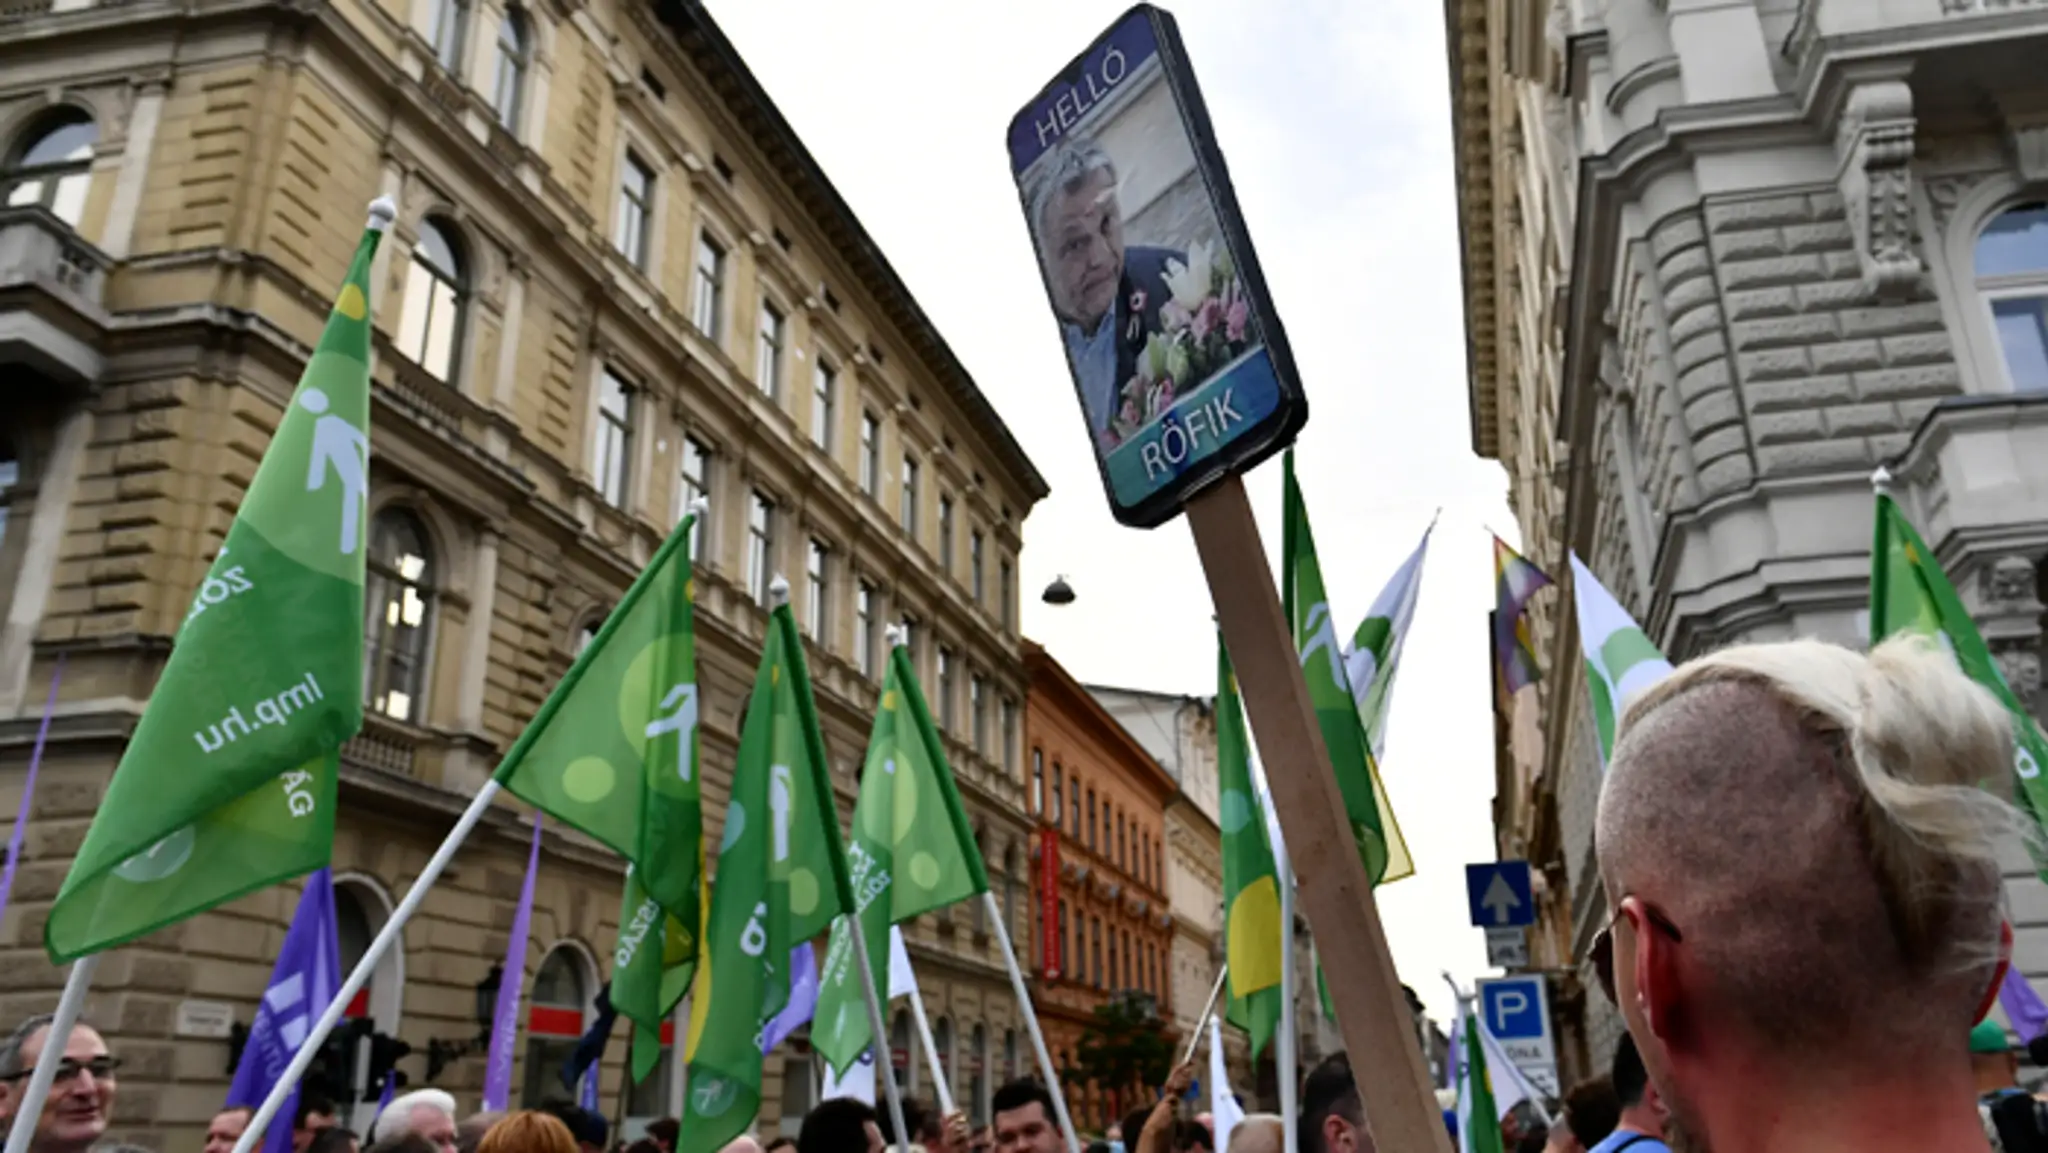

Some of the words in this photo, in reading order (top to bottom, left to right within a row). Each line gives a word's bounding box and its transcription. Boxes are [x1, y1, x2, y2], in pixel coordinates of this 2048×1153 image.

[1035, 43, 1126, 148] HELLÓ
[1140, 387, 1242, 481] RÖFIK
[1495, 991, 1528, 1030] P
